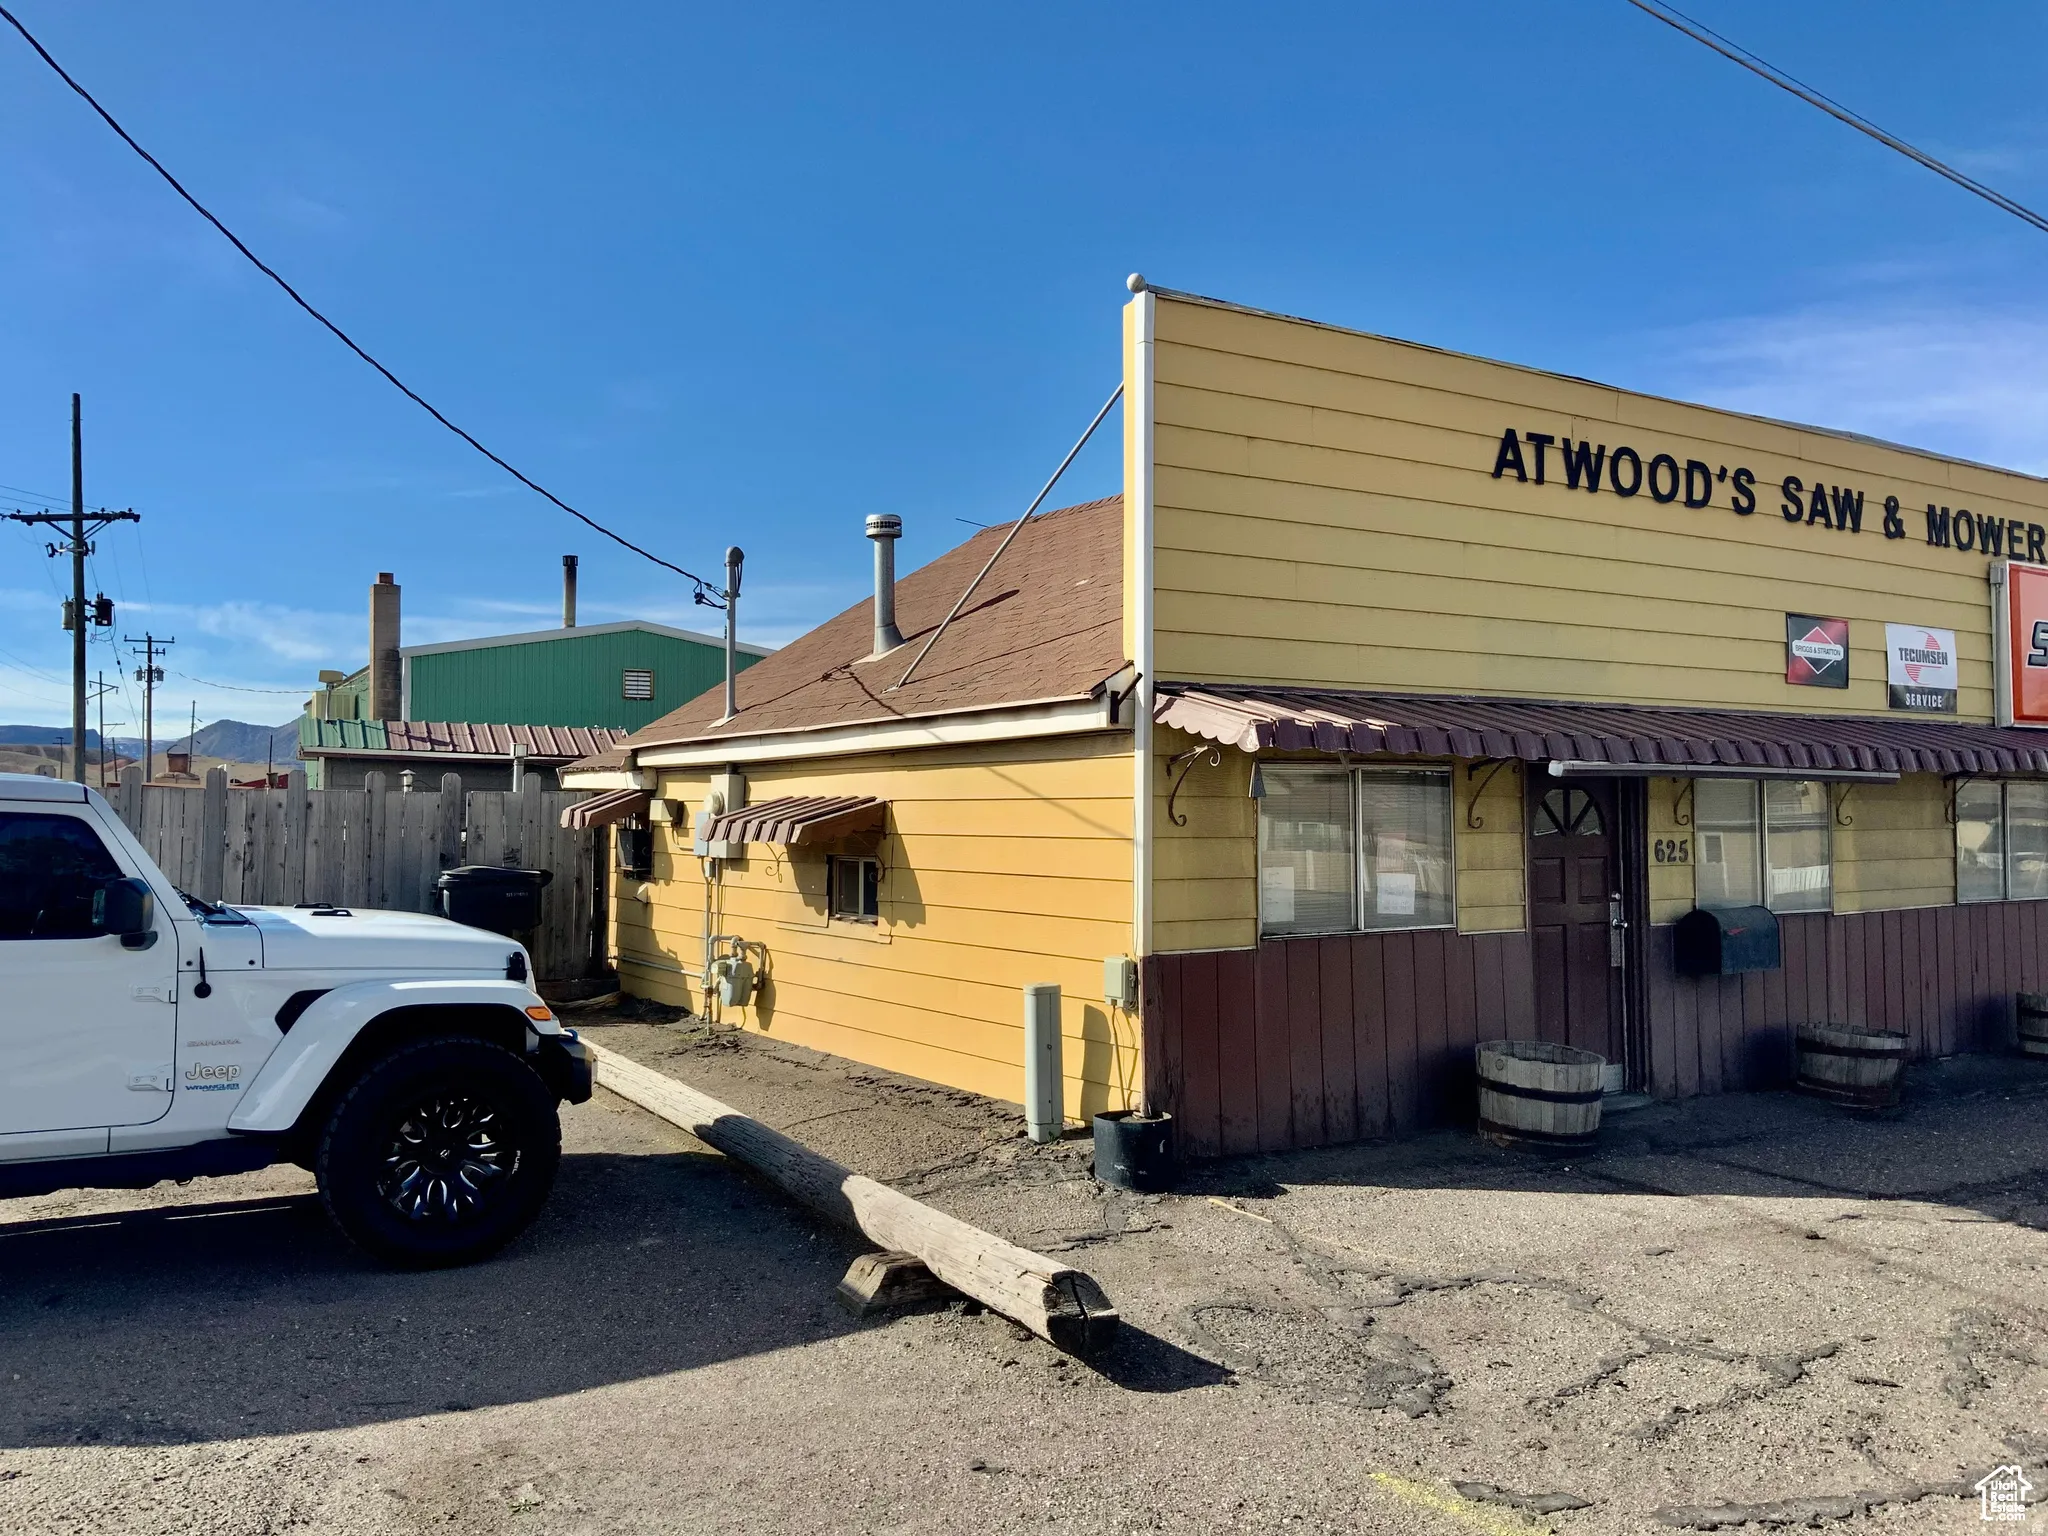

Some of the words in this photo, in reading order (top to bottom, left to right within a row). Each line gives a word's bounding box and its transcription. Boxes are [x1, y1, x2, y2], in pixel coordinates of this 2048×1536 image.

[1491, 428, 1757, 516] ATWOOD'S
[1780, 475, 1865, 534] SAW
[1883, 495, 1907, 540] &
[1926, 503, 2048, 564] MOWER
[1794, 644, 1813, 654] BRIGGS
[1813, 645, 1818, 654] &
[1817, 647, 1842, 657] STRATTON
[1898, 647, 1949, 666] TECUMSEH
[1905, 693, 1943, 708] SERVICE
[1654, 838, 1689, 863] 625
[185, 1062, 242, 1082] Jeep
[185, 1083, 240, 1091] WRANGLER
[511, 1150, 521, 1175] FUEL
